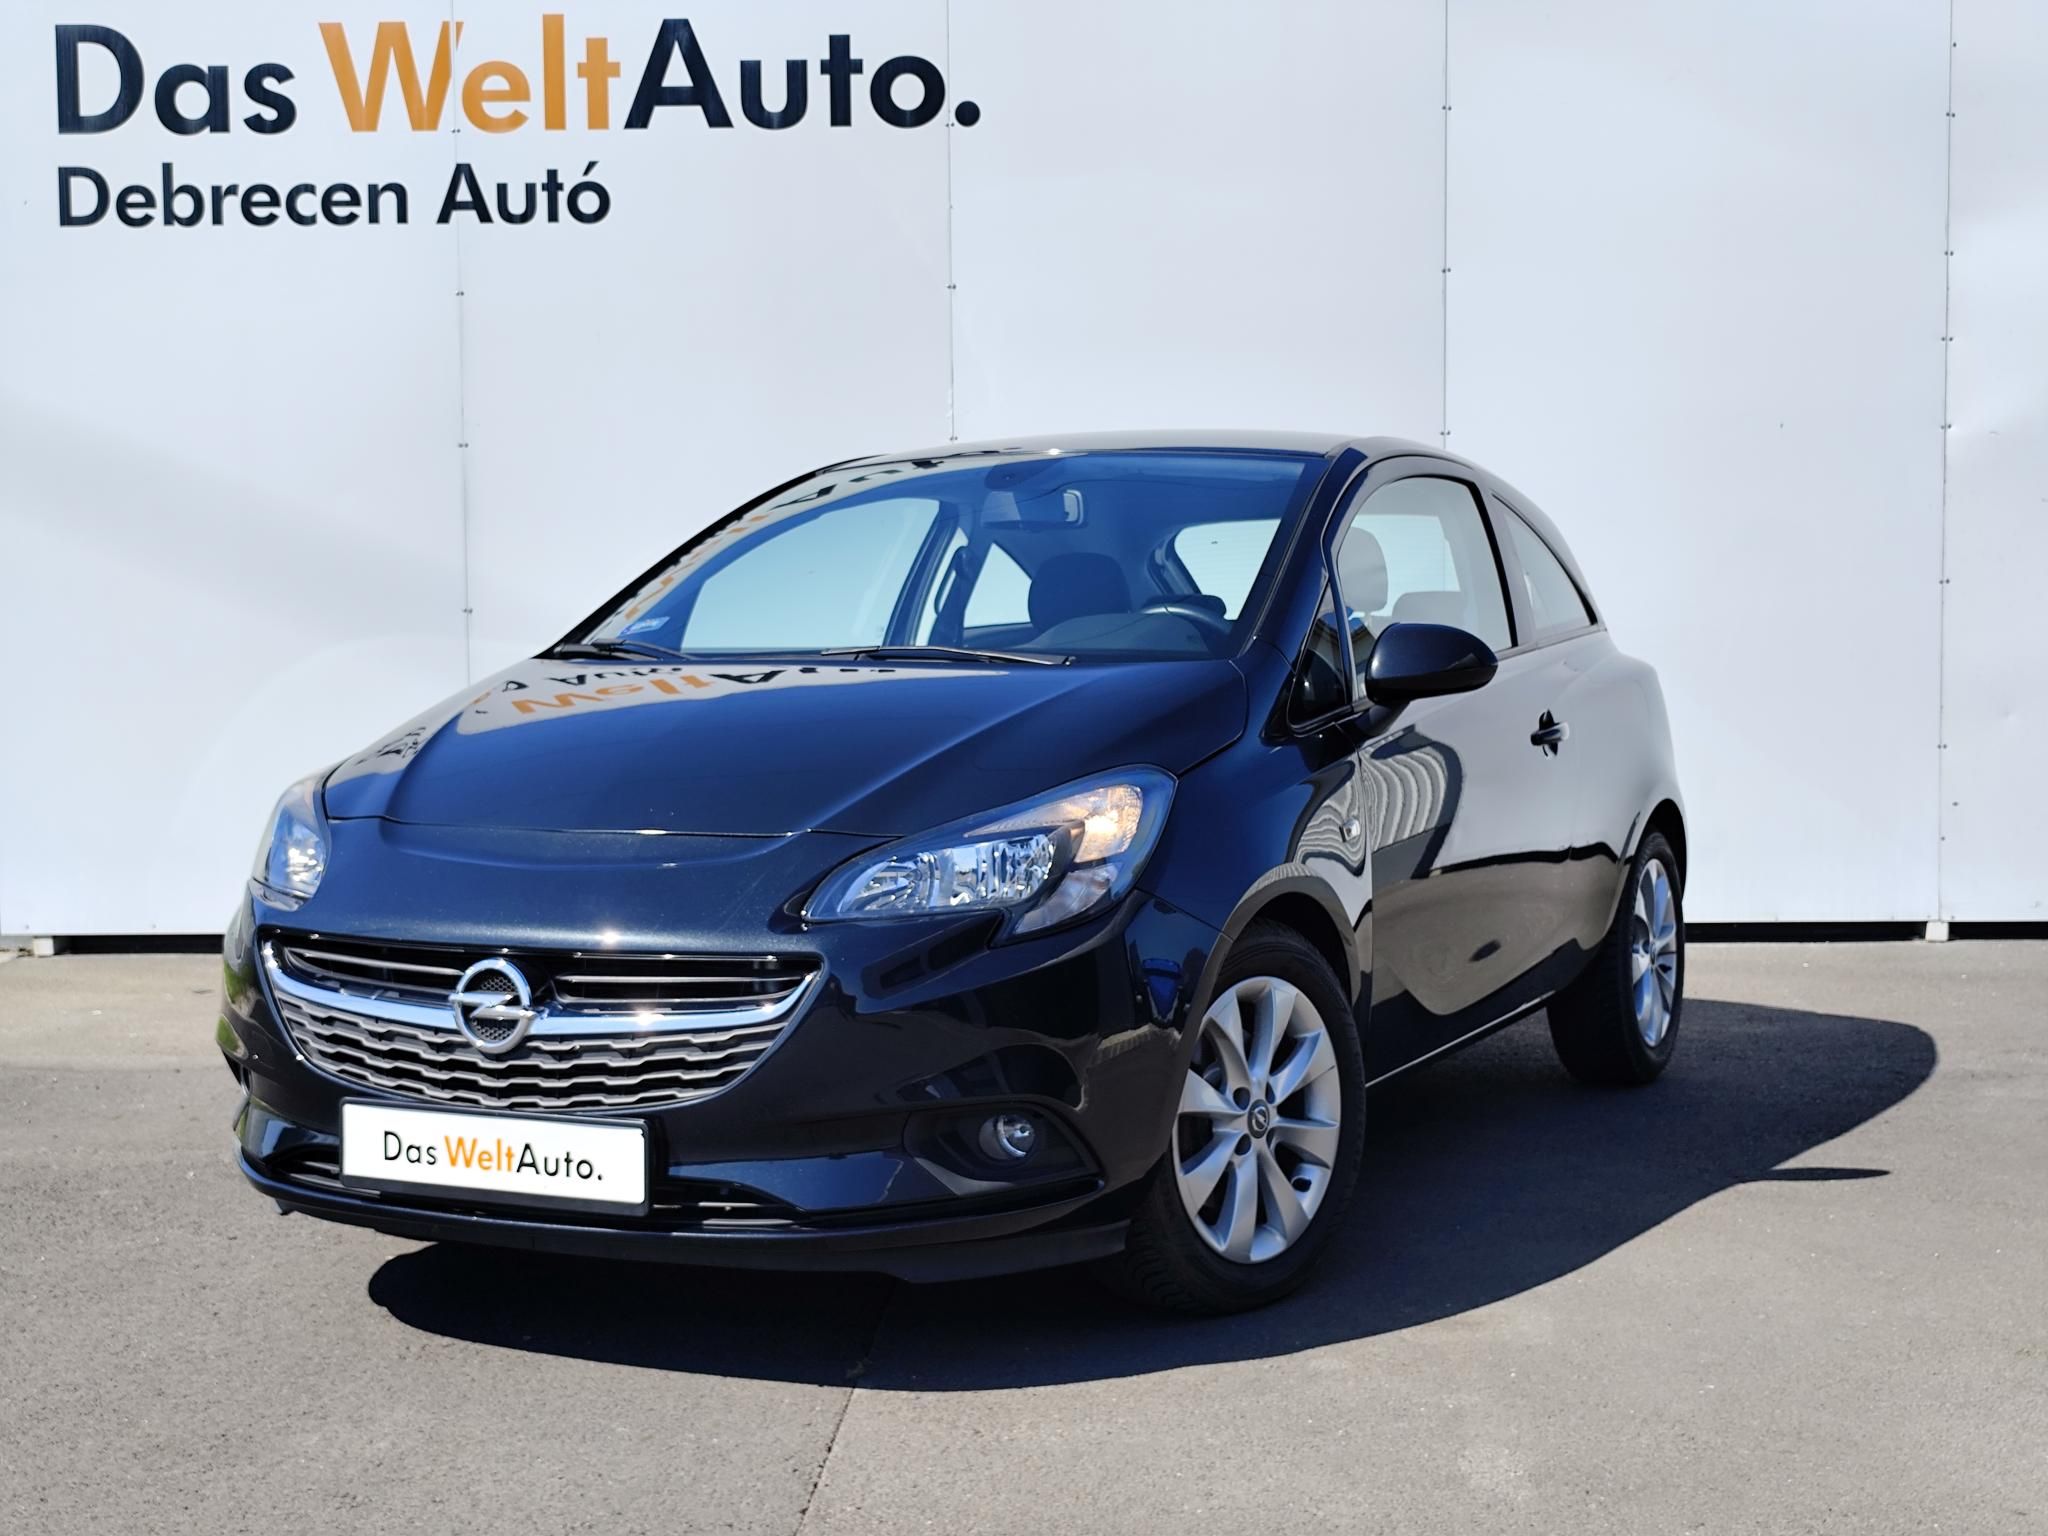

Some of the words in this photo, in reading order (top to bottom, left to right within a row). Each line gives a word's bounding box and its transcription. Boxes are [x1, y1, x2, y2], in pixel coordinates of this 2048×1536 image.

[55, 24, 297, 135] Das
[320, 15, 981, 132] WeltAuto.
[58, 162, 409, 228] Debrecen
[437, 161, 611, 225] Autó
[383, 1130, 437, 1166] Das
[444, 1135, 603, 1181] WeltAuto.
